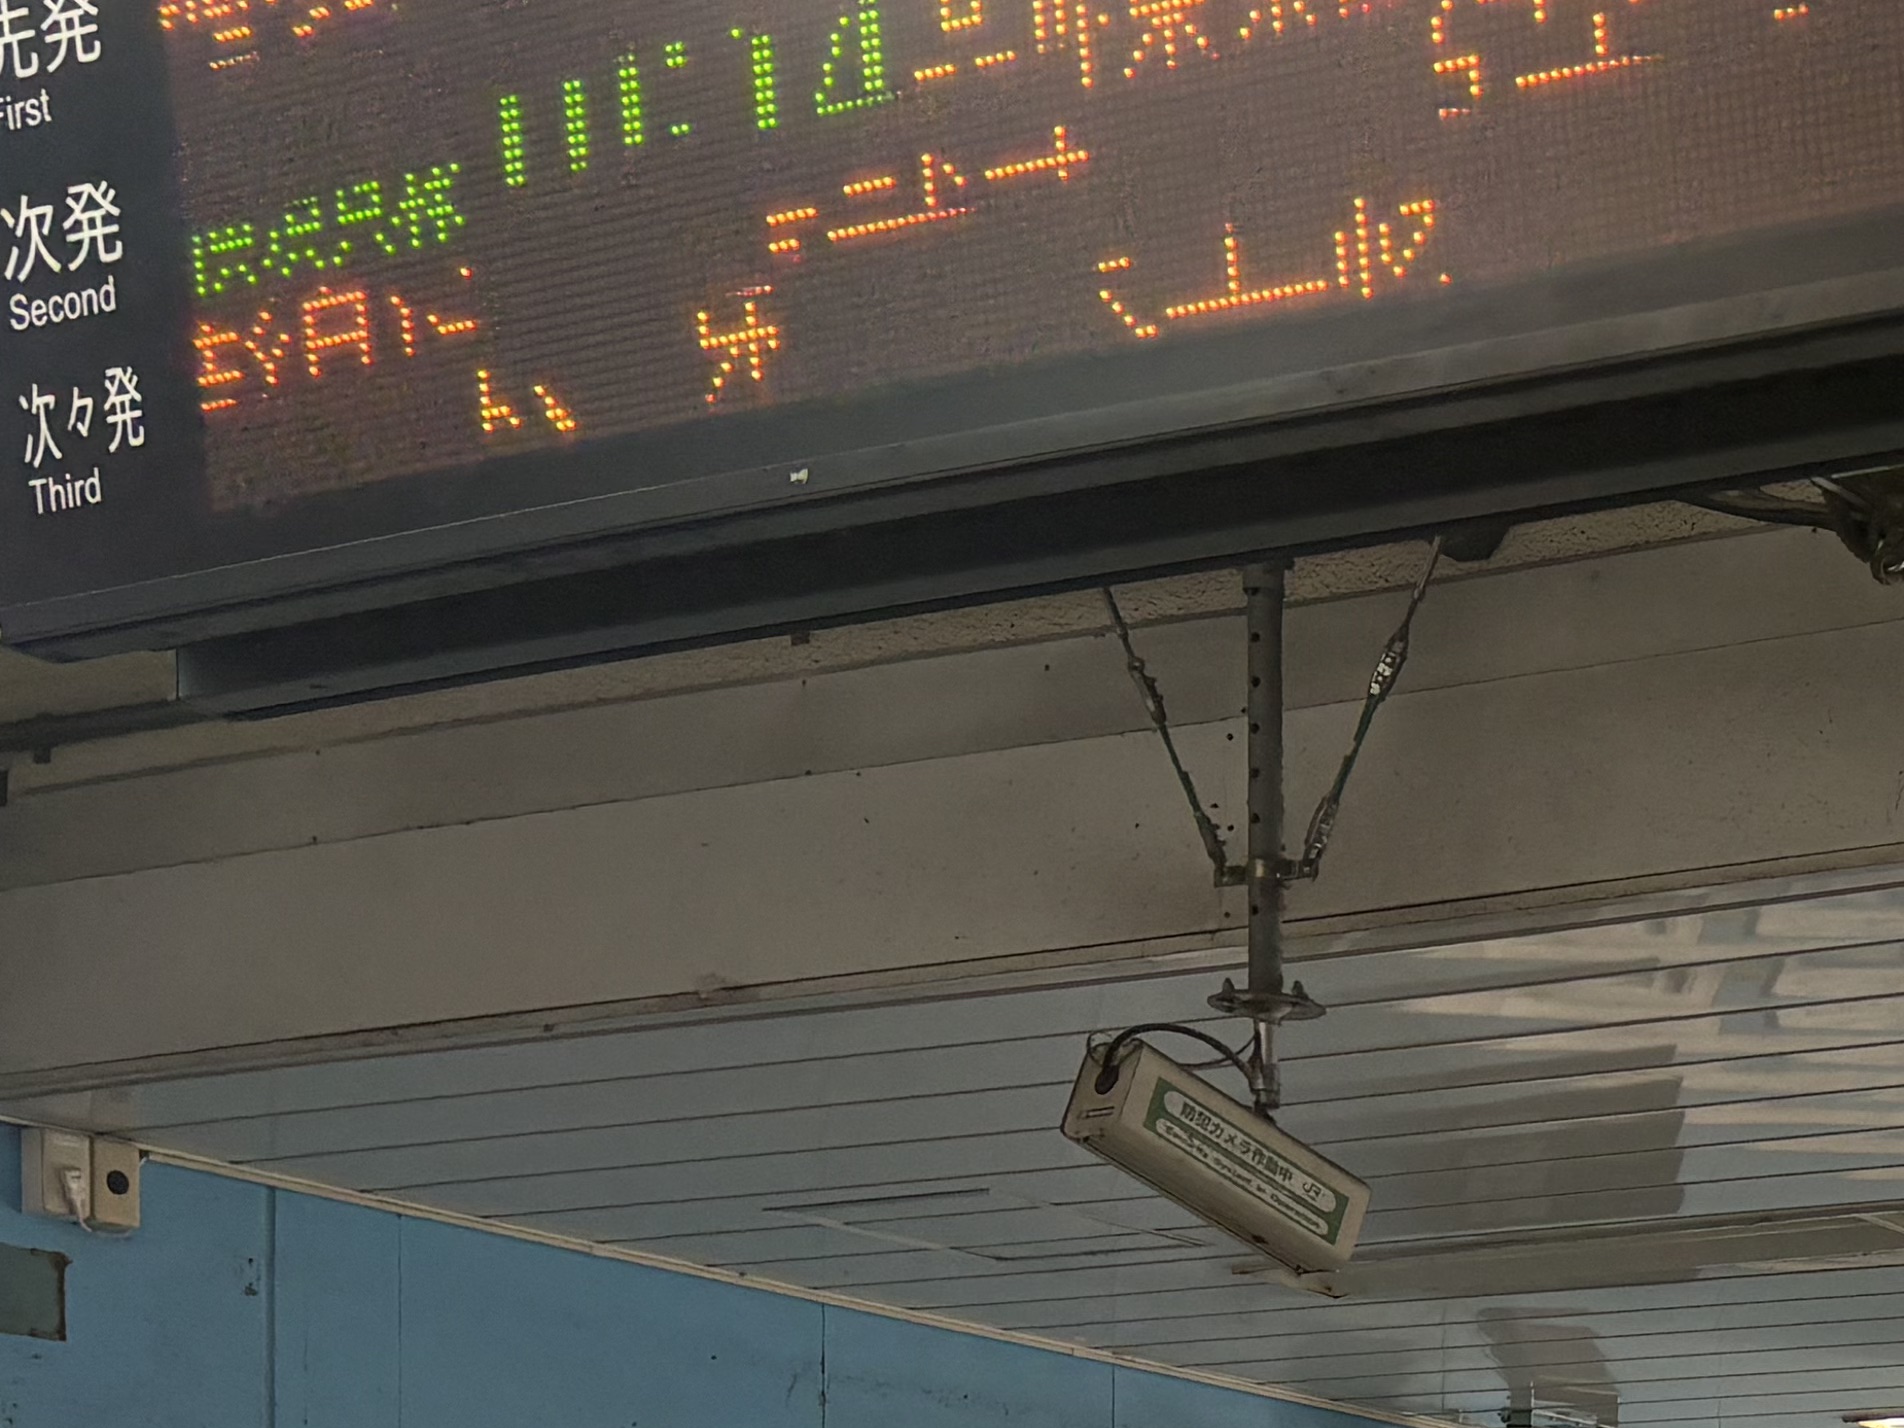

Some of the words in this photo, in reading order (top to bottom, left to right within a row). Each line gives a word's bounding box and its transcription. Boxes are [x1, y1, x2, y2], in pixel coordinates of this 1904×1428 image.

[1, 181, 123, 283] 次発
[9, 276, 117, 332] Second
[19, 366, 145, 468] 次々発
[29, 467, 102, 515] Third
[1179, 1100, 1294, 1183] 防犯カメラ作動中
